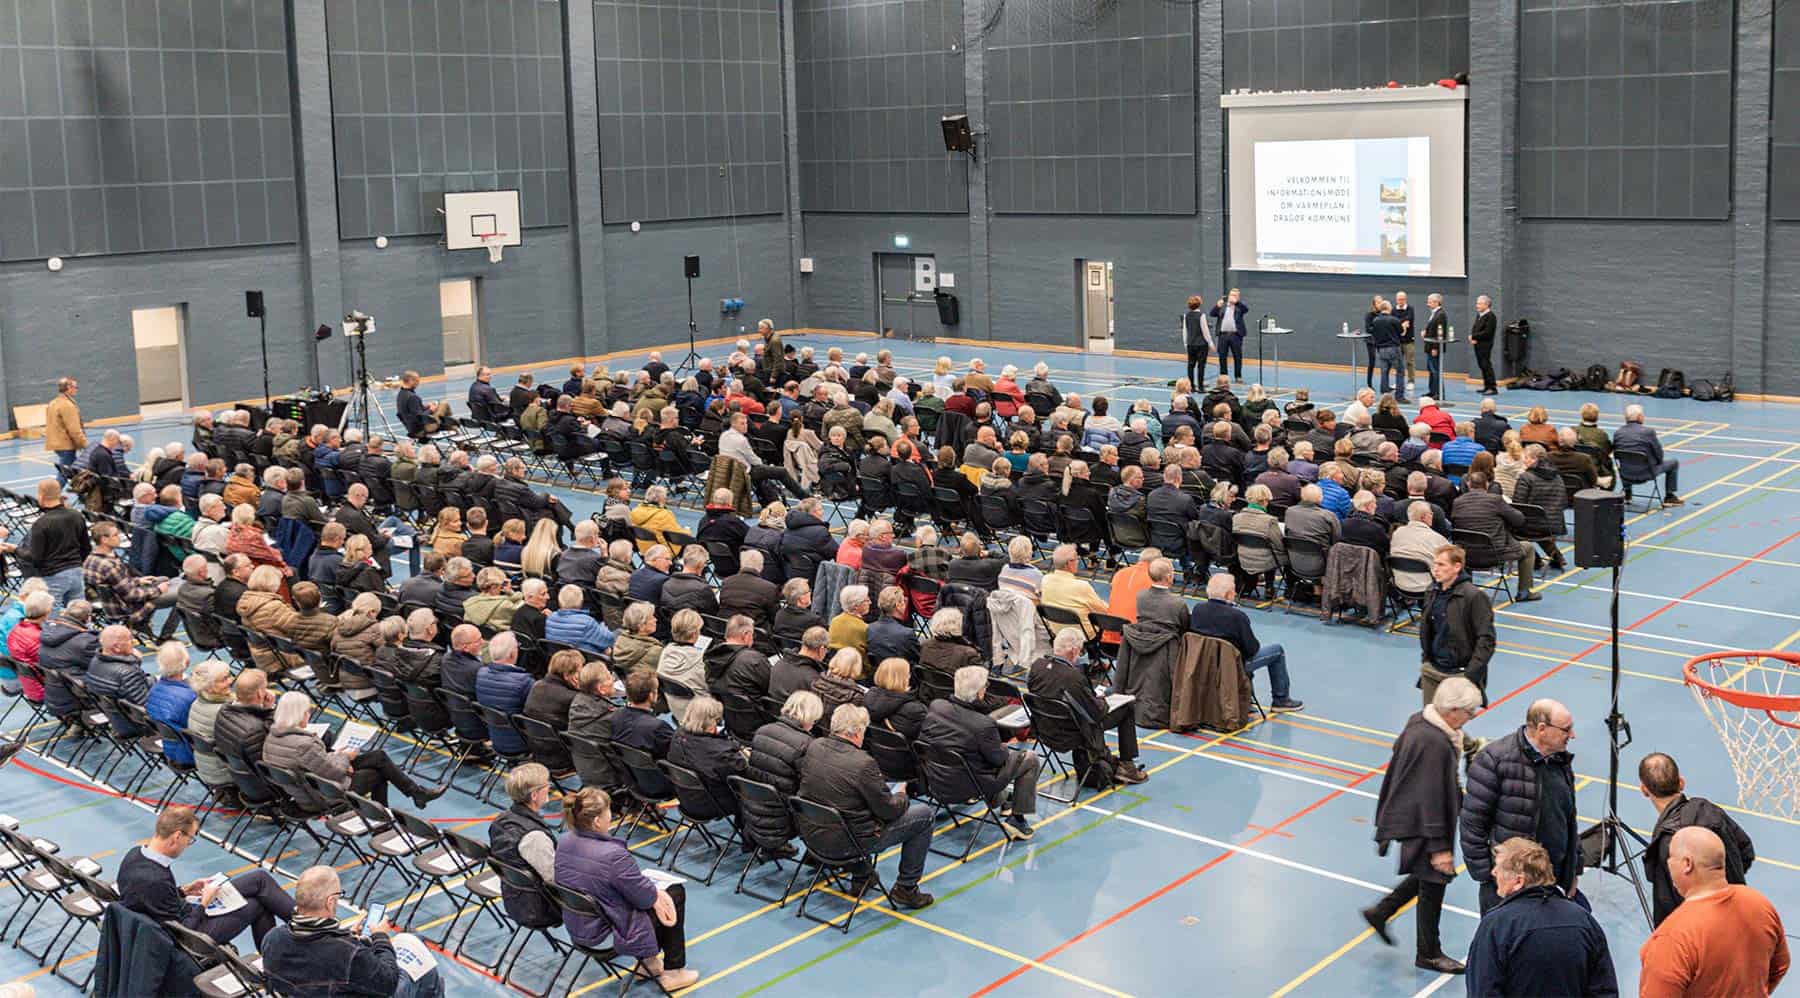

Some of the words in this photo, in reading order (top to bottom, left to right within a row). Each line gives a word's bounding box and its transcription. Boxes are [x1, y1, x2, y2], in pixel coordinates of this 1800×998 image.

[1286, 176, 1336, 184] VELKOMMEN
[1339, 176, 1350, 184] TIL
[1266, 188, 1350, 197] INFORMATIONSMØDE
[1280, 201, 1293, 209] OM
[1296, 201, 1344, 209] VARMEPLAN
[1273, 214, 1305, 222] DRAGØR
[1308, 214, 1350, 222] KOMMUNE
[915, 257, 936, 291] B
